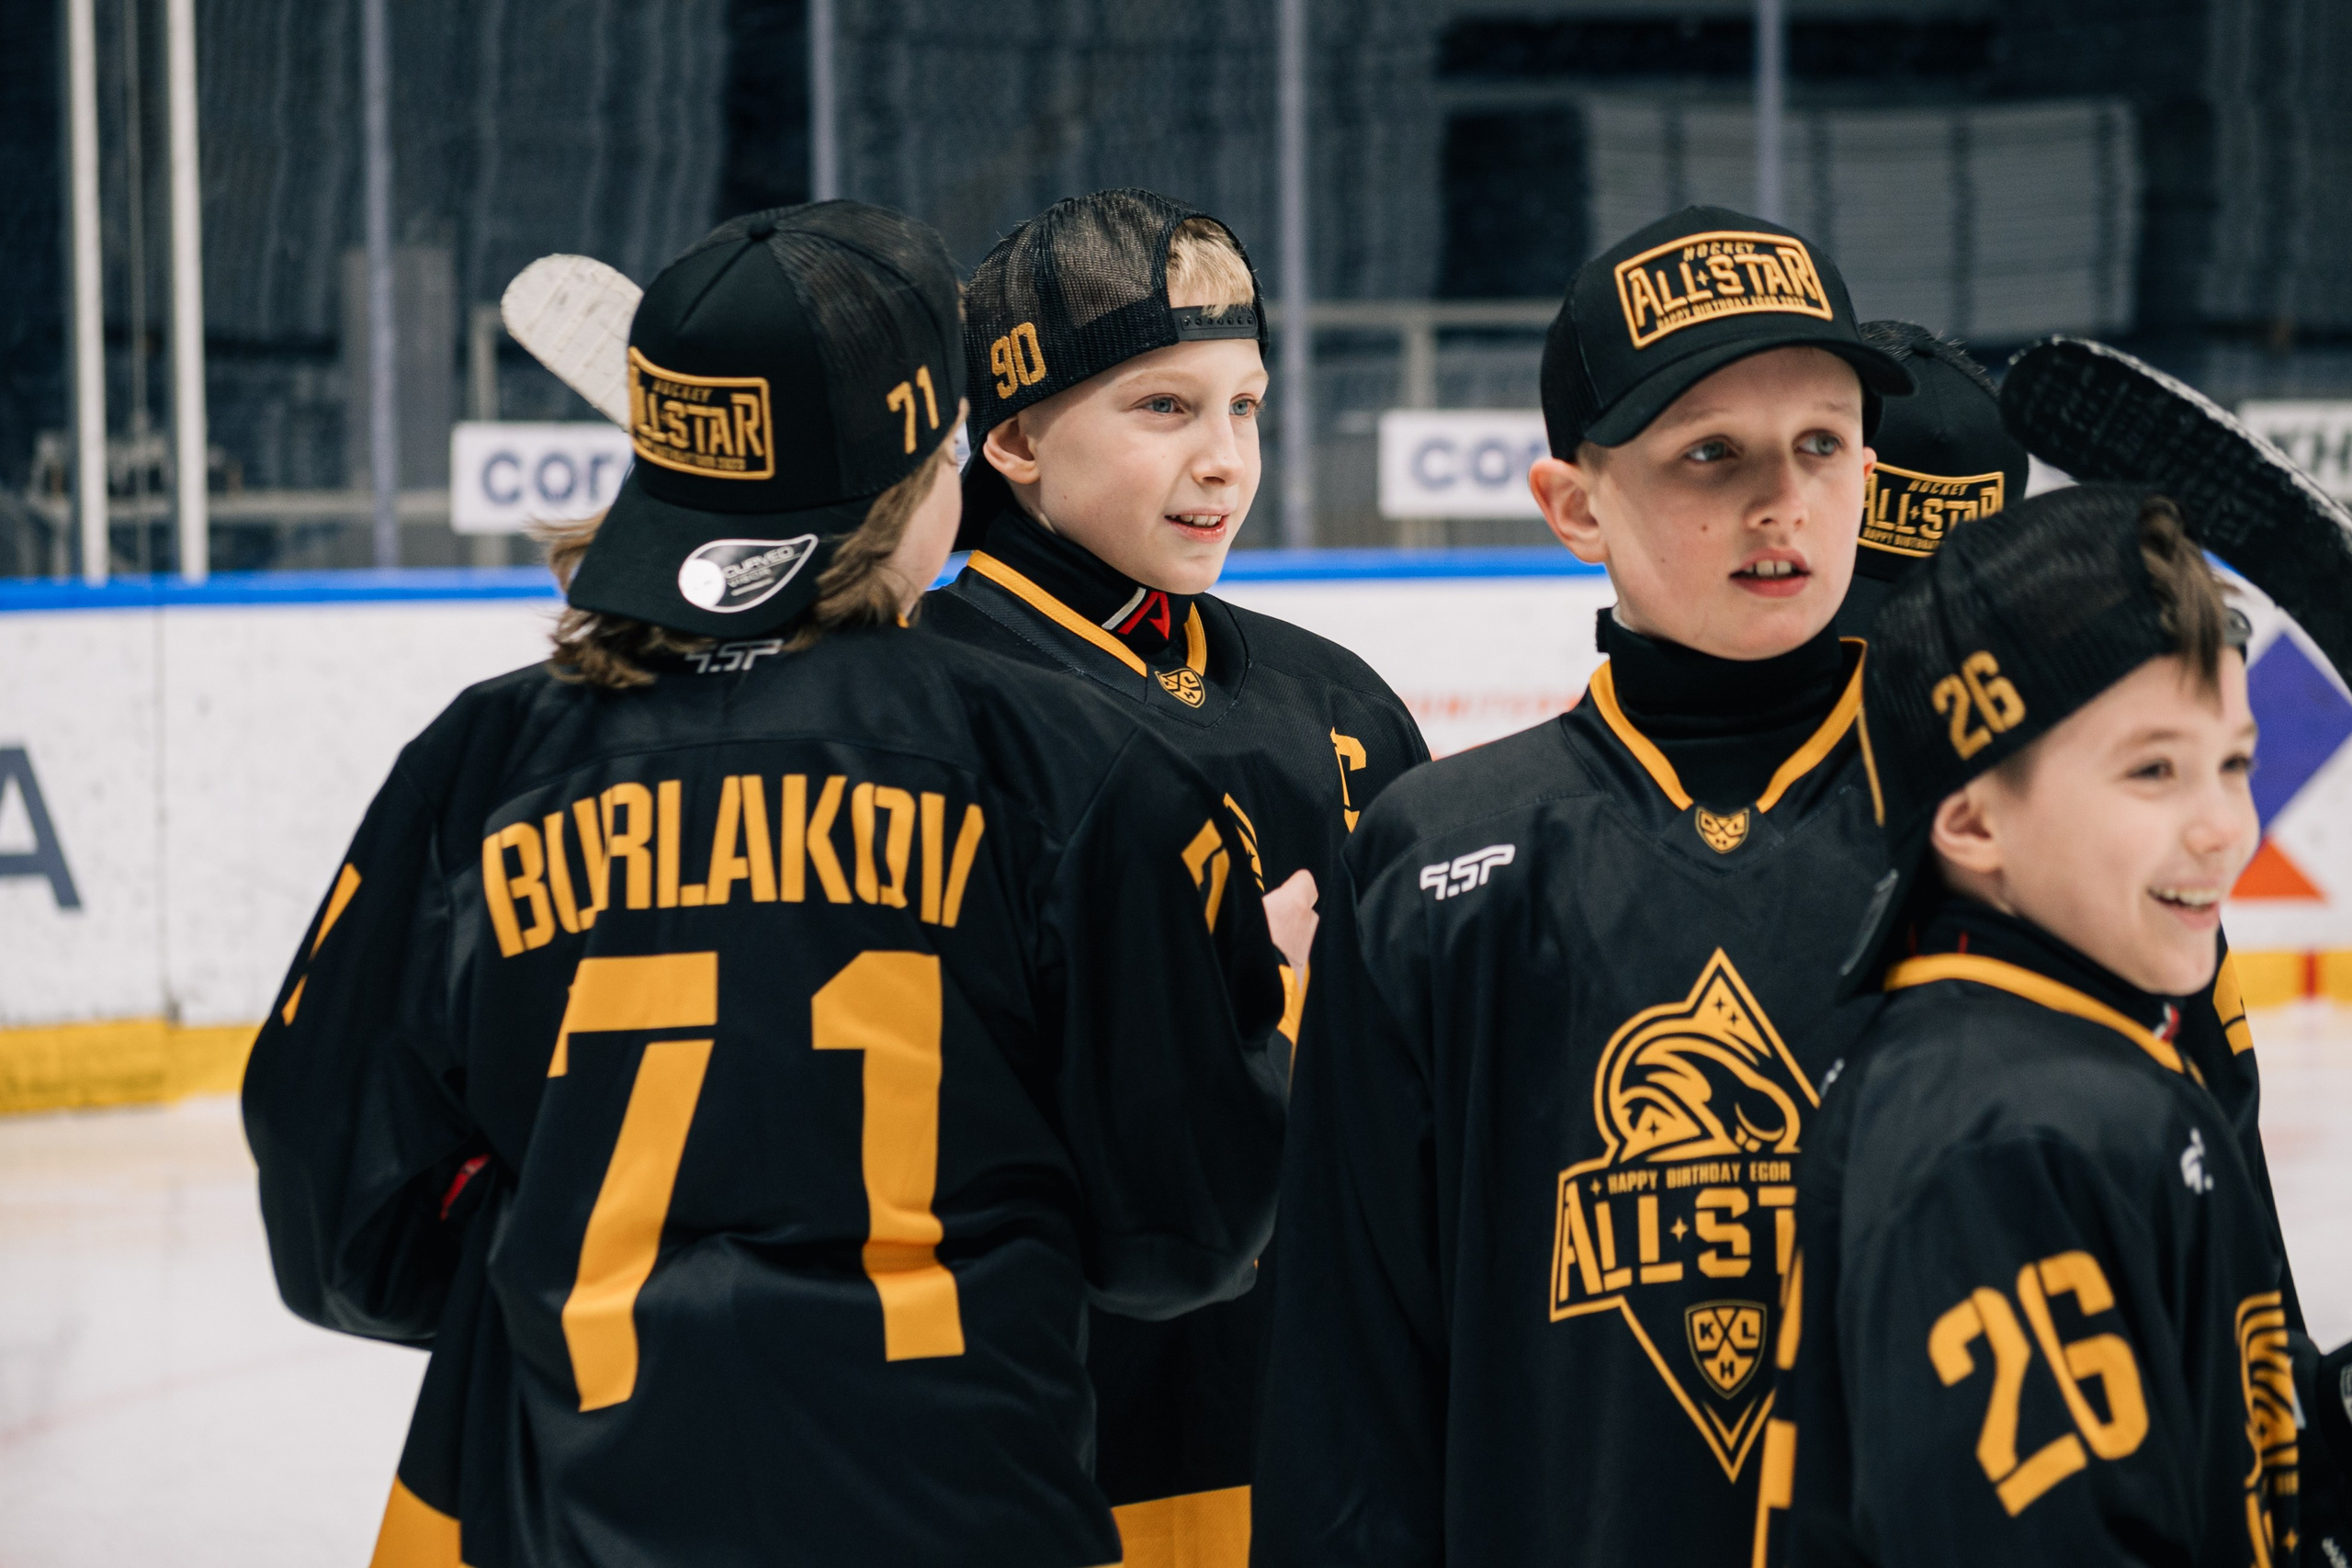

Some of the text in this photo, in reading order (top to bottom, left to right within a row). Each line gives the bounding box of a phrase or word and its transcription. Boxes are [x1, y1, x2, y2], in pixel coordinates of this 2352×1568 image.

[1682, 241, 1757, 263] HOCKEY
[1705, 245, 1820, 301] STAR
[990, 321, 1047, 400] 90
[663, 390, 765, 457] STAR
[886, 365, 940, 455] 71
[1906, 479, 1971, 497] HOCKEY
[722, 545, 795, 580] CURVED
[1931, 649, 2027, 761] 26
[482, 773, 985, 958] BURLAKOV
[548, 950, 966, 1413] 71
[1608, 1161, 1792, 1194] HAPPY BIRTHDAY EGOR
[1928, 1250, 2149, 1517] 26
